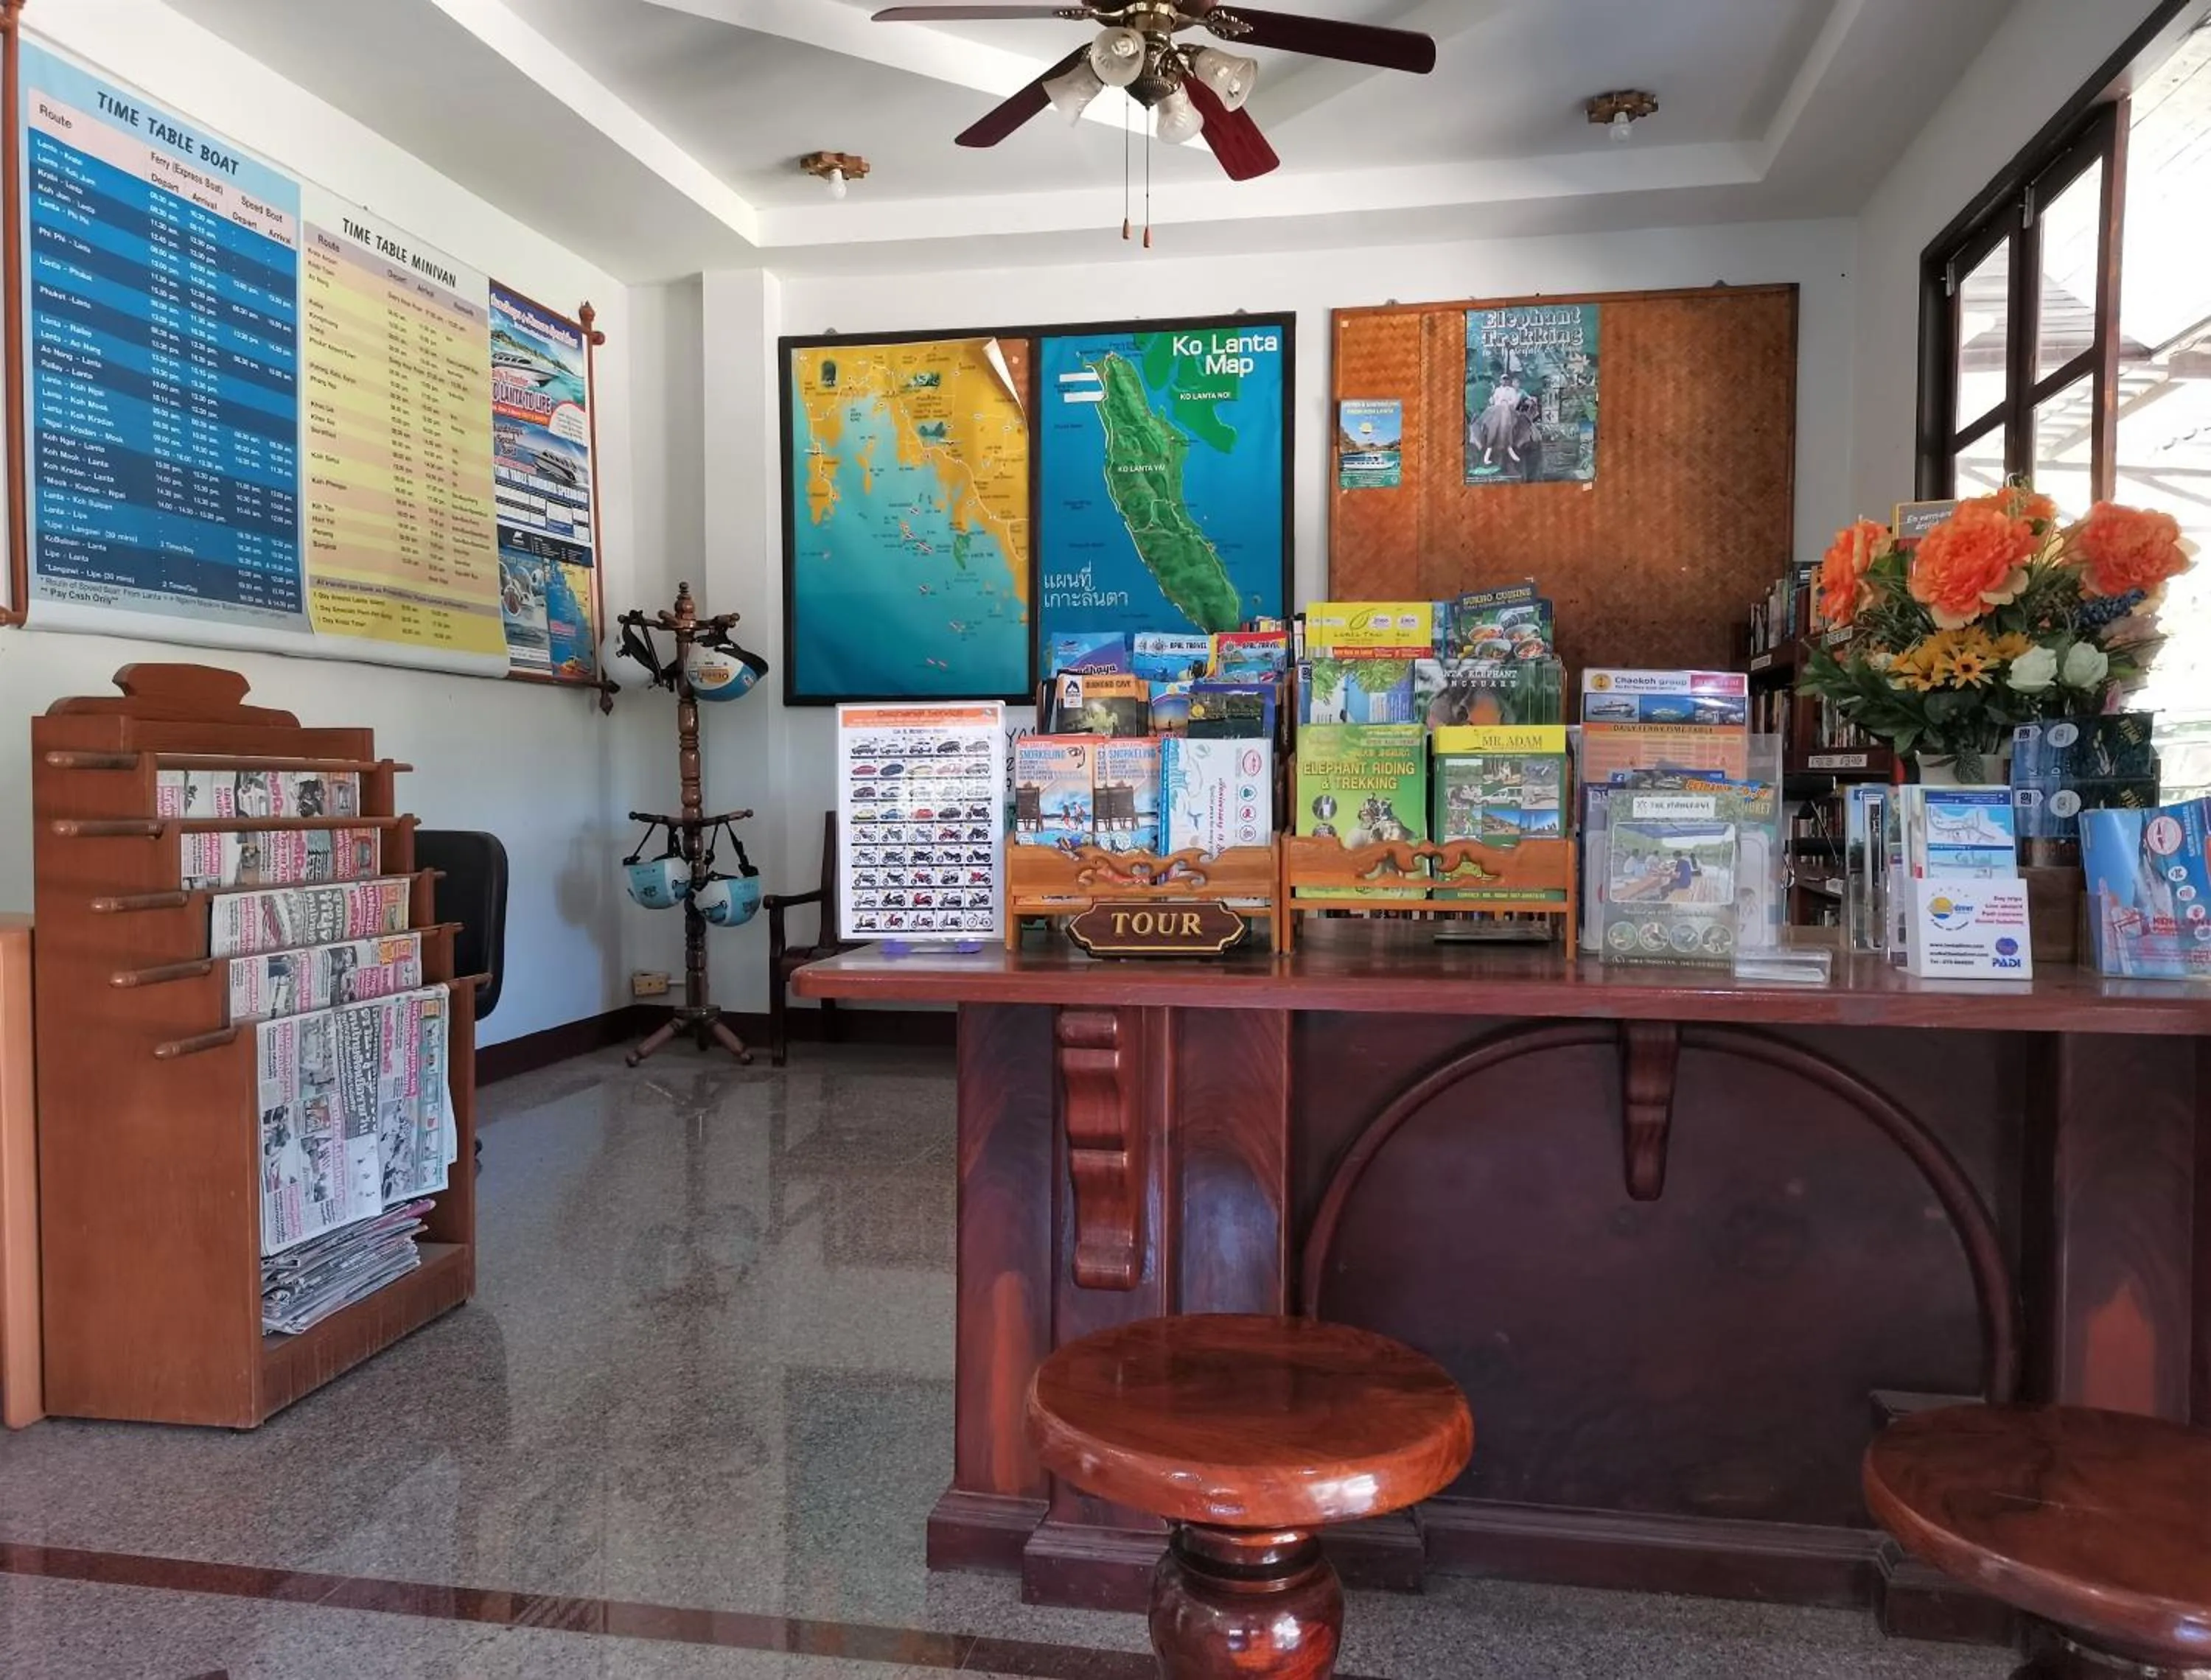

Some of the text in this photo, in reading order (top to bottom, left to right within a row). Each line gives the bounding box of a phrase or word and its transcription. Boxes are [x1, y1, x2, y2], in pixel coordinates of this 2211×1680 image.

[38, 103, 73, 129] Route
[97, 91, 240, 176] TIME TABLE BOAT
[318, 234, 340, 253] Route
[343, 217, 457, 288] TIME TABLE MINIVAN
[1481, 307, 1582, 330] Elephant
[1173, 334, 1278, 356] Ko Lanta
[1481, 328, 1584, 347] Trekking
[1205, 355, 1254, 378] Map
[1192, 392, 1216, 400] LANTA
[1044, 560, 1092, 589] แผนที่
[1044, 584, 1128, 609] เกาะลันตา
[1468, 670, 1518, 679] ELEPHANT
[1506, 735, 1543, 746] ADAM
[1019, 748, 1065, 759] SNORKELING
[1303, 761, 1415, 775] ELEPHANT RIDING
[1321, 777, 1397, 790] & TREKKING
[1111, 911, 1203, 936] TOUR
[1992, 957, 2021, 967] PADI
